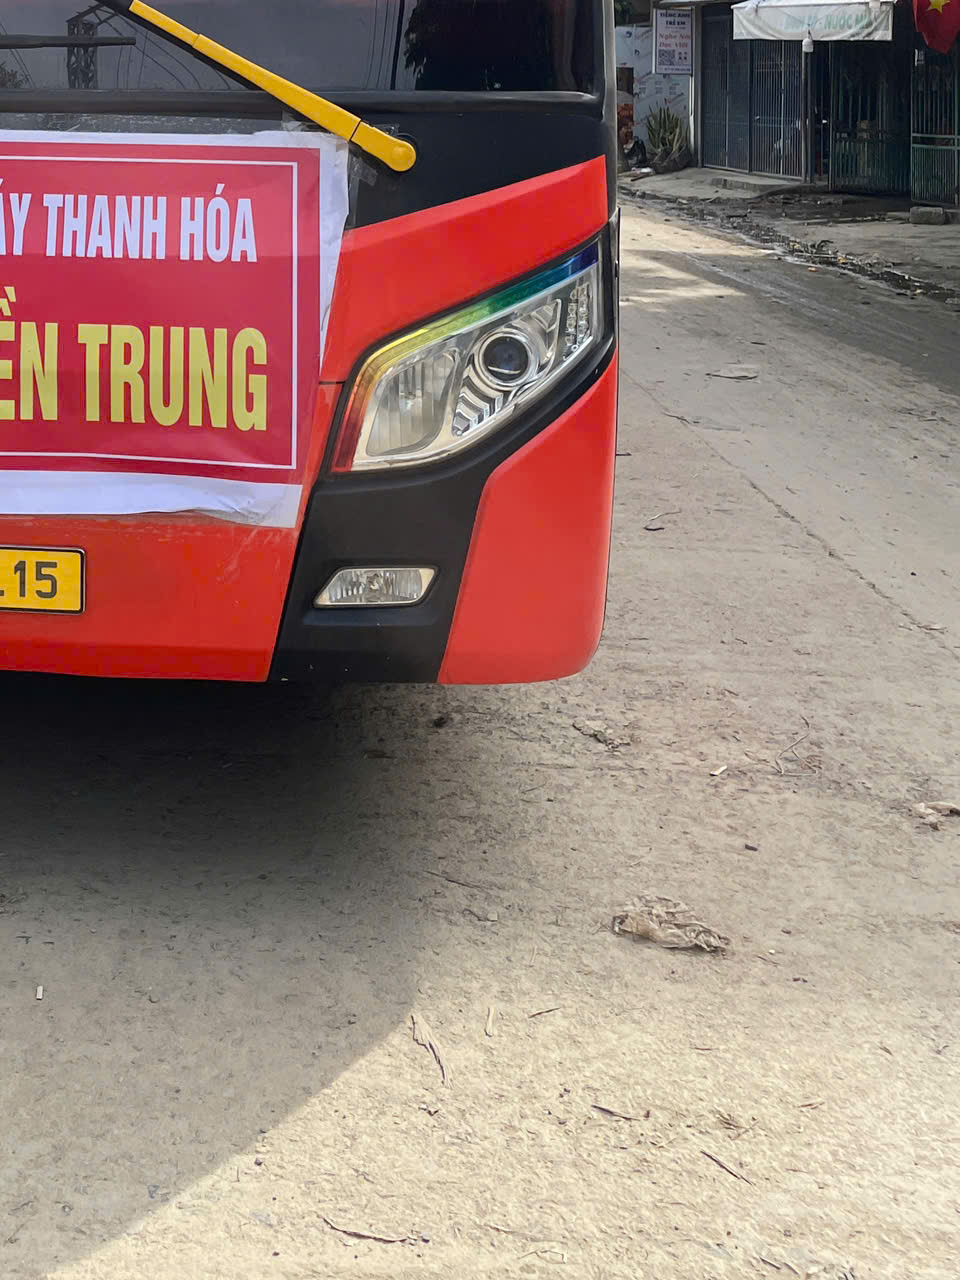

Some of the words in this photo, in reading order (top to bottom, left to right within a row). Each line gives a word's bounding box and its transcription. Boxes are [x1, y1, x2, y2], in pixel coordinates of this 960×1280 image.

[43, 193, 167, 260] THANH
[180, 183, 257, 262] HÓA
[77, 323, 267, 431] TRUNG
